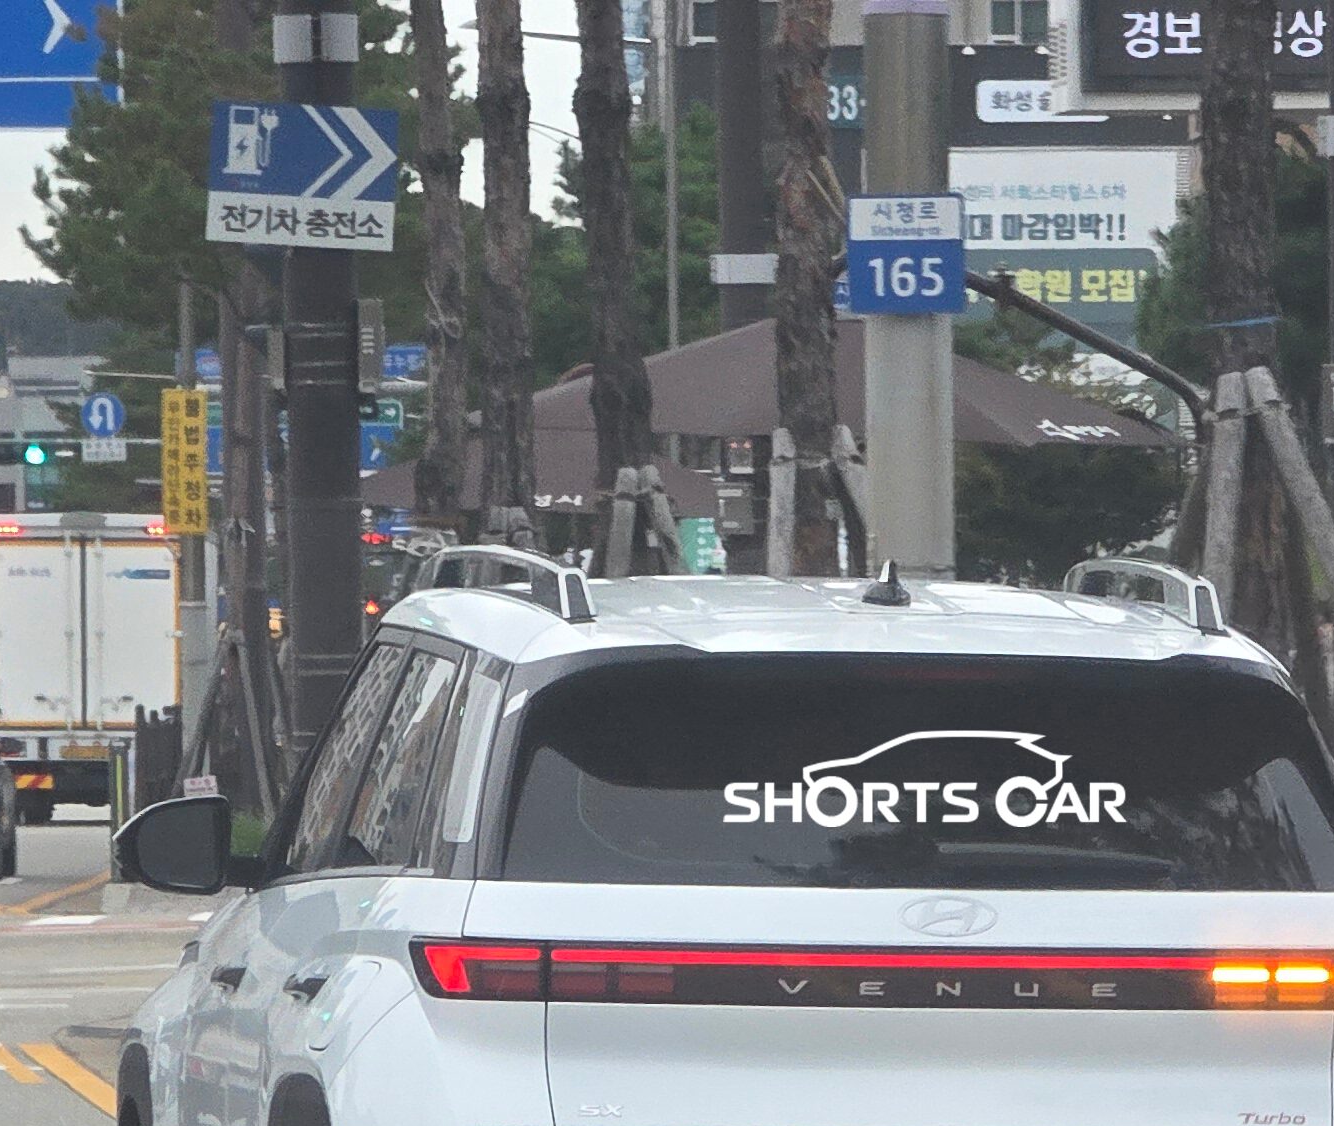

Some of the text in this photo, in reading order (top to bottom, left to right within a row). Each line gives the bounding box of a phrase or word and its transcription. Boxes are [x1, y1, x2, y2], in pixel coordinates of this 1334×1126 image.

[1122, 11, 1203, 59] 경보
[220, 203, 384, 240] 전기차 충전소
[873, 201, 940, 224] 시청로
[1001, 213, 1126, 241] 마감임박!!
[868, 257, 944, 297] 165
[989, 268, 1072, 303] 합원
[778, 978, 1118, 998] VENUE
[1238, 1112, 1306, 1125] Turbo
